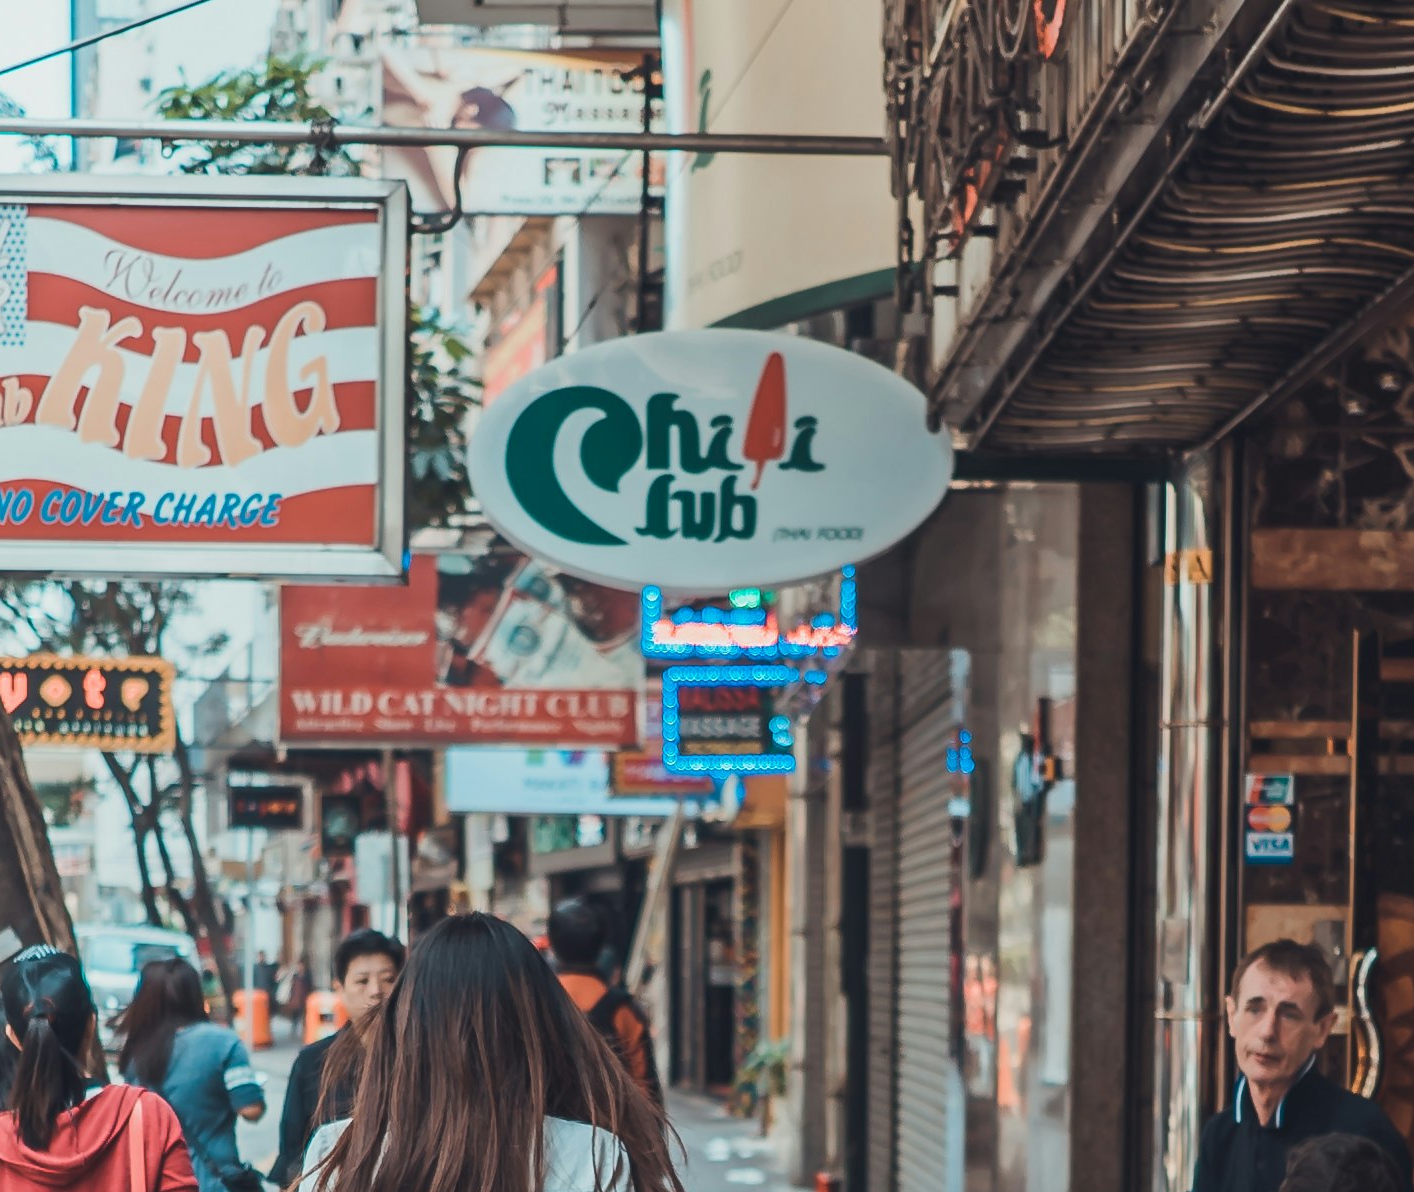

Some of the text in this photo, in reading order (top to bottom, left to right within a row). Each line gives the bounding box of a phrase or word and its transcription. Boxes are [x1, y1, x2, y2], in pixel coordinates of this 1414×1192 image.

[104, 250, 283, 308] Welcome to
[34, 301, 341, 469] KING
[40, 489, 146, 529] COVER
[152, 492, 284, 529] CHARGE
[291, 690, 630, 719] WILD CAT NIGHT CLUB
